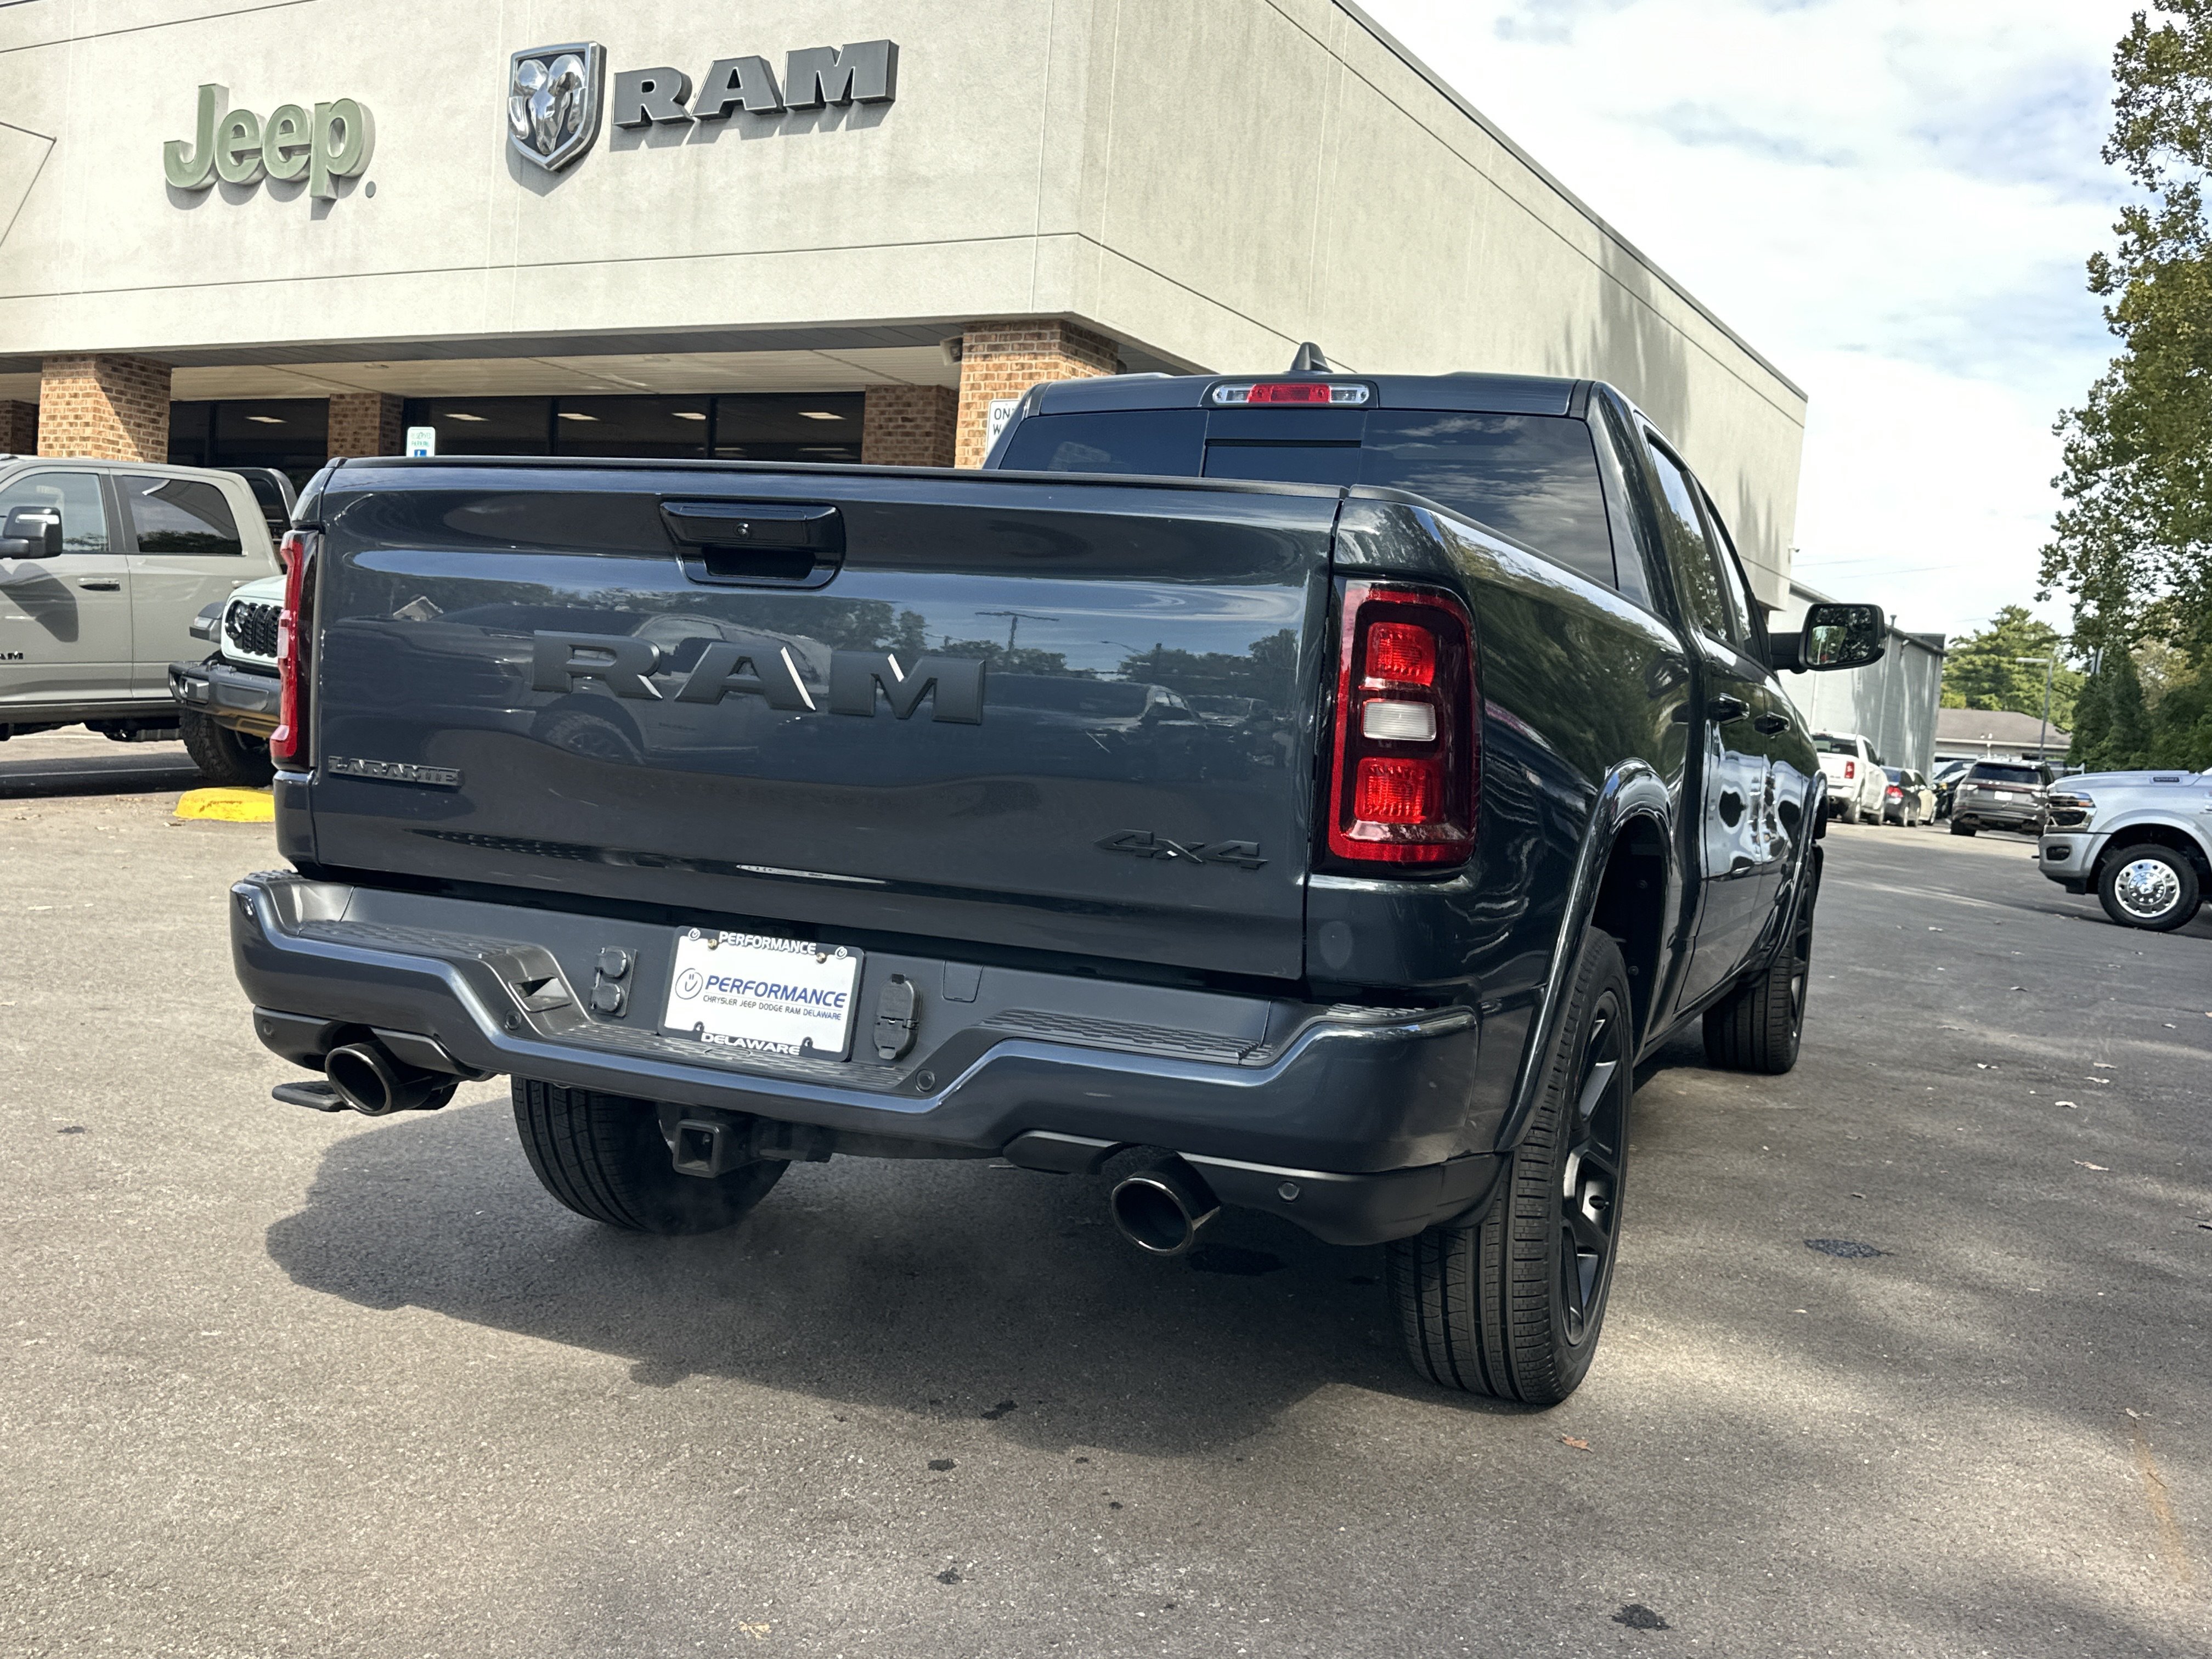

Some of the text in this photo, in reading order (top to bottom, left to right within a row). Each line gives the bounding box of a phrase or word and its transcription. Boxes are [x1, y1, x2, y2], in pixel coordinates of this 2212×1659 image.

[612, 40, 899, 129] RAM
[994, 408, 1015, 420] ON
[532, 630, 986, 725] RAM
[328, 755, 465, 787] LARAMIE
[719, 931, 816, 955] PERFORMANCE
[705, 975, 848, 1008] PERFORMANCE
[703, 995, 842, 1021] CHRYSLER JEEP DODGE RAM DELAWARE
[701, 1032, 801, 1056] DELAWARE
